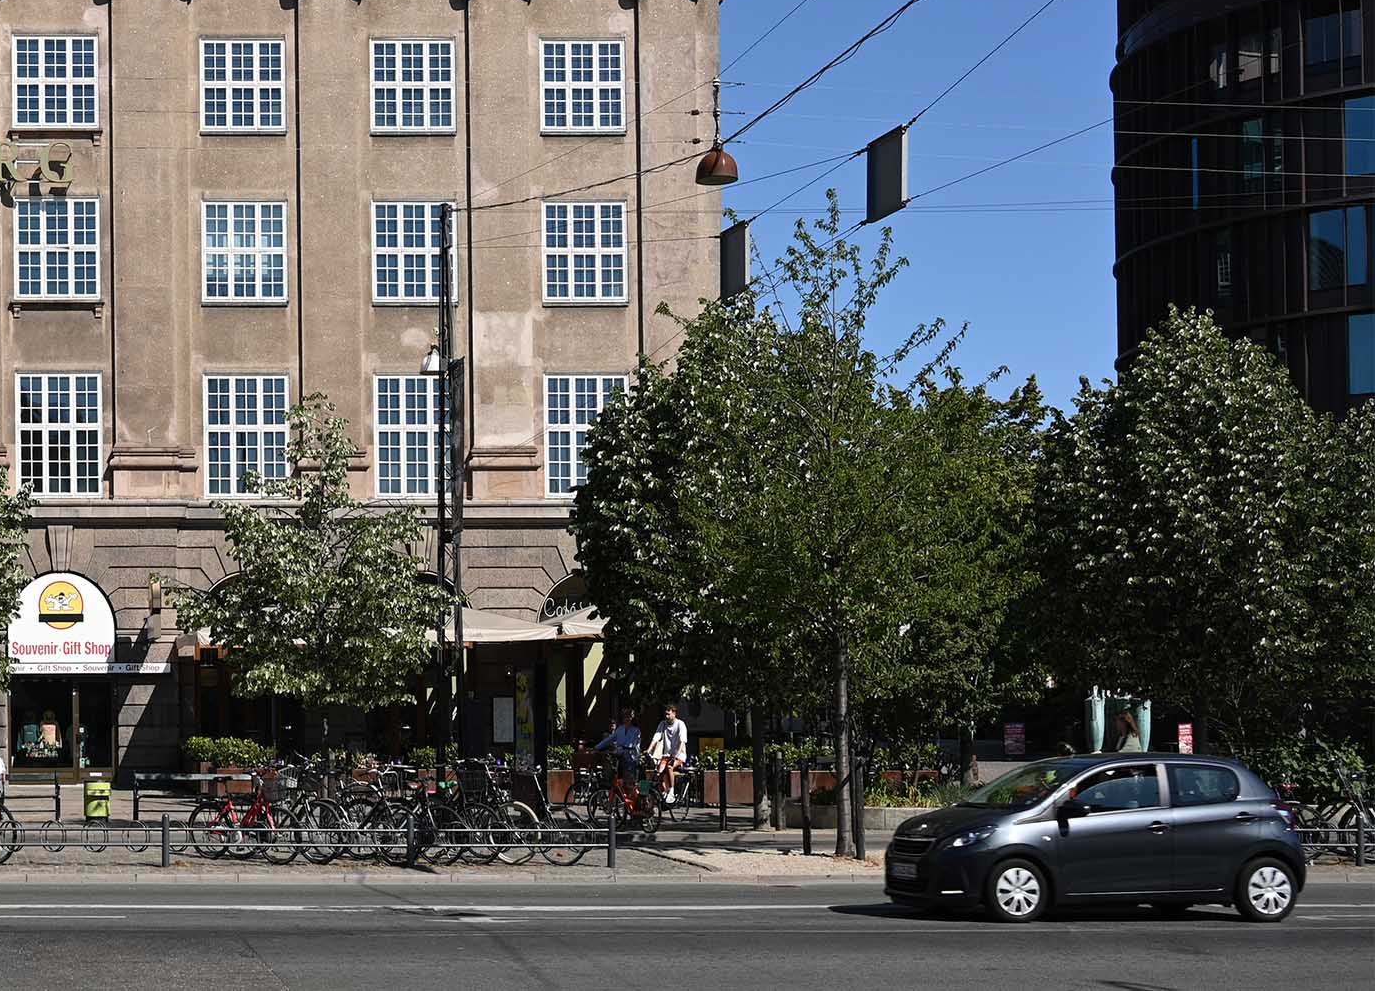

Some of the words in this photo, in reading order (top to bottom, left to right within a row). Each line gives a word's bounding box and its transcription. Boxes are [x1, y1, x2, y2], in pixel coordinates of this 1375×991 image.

[12, 641, 58, 656] Souvenir
[63, 641, 82, 656] Gift
[84, 641, 111, 657] Shop
[37, 664, 52, 673] Gift
[52, 664, 72, 674] Shop
[83, 664, 115, 673] Souvenir
[125, 664, 140, 673] Gift
[140, 664, 161, 674] Shop
